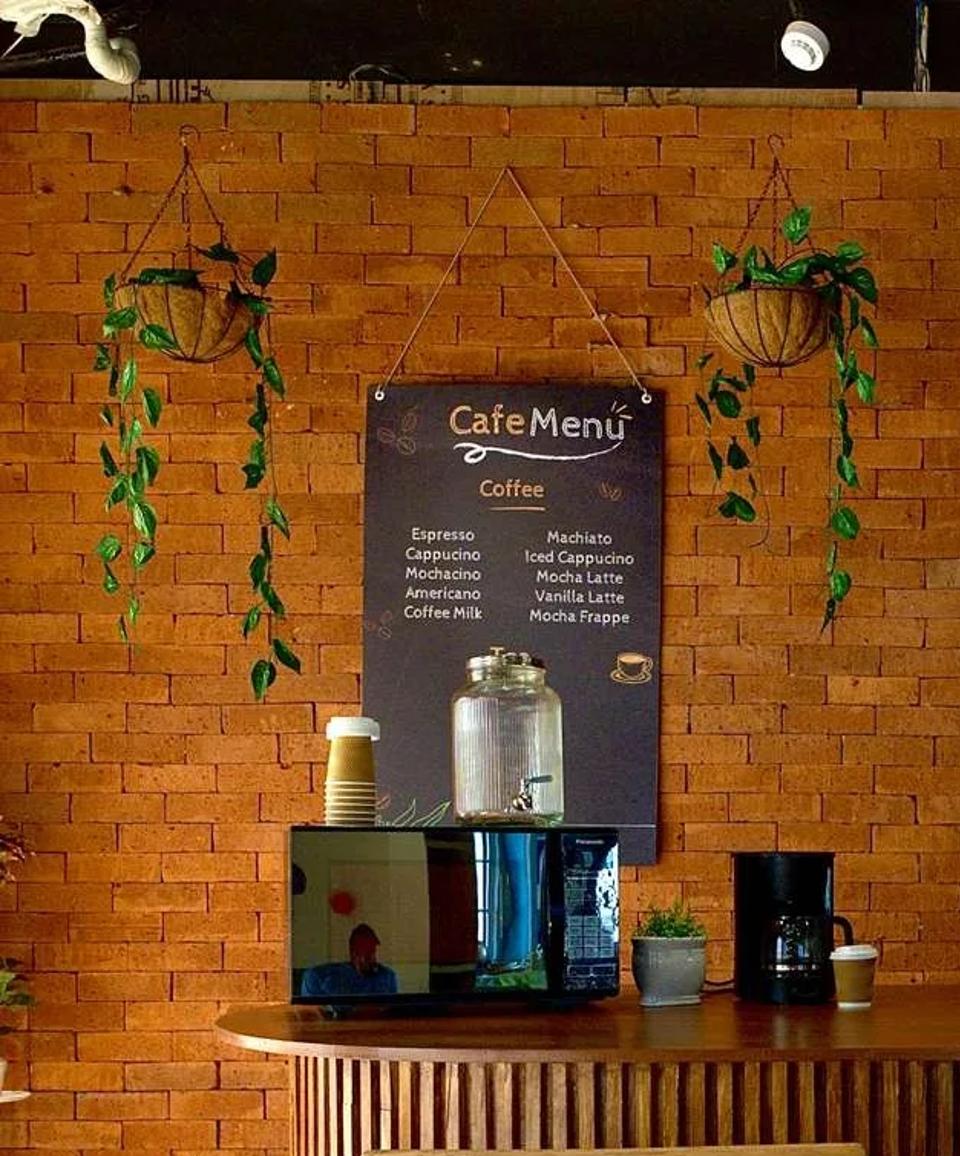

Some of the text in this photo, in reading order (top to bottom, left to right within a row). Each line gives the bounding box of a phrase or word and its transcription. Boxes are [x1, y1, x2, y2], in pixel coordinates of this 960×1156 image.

[450, 404, 625, 440] Cafe Menu
[480, 479, 543, 497] Coffee
[411, 527, 475, 542] Espresso
[547, 531, 612, 544] Machiato
[406, 547, 480, 563] Cappucino
[525, 550, 634, 567] Iced Cappucino
[406, 567, 481, 580] Mochacino
[537, 570, 623, 584] Mocha Latte
[406, 586, 480, 600] Americano
[535, 589, 624, 604] Vanilla Latte
[404, 605, 482, 619] Coffee Milk
[530, 609, 629, 626] Mocha Frappe
